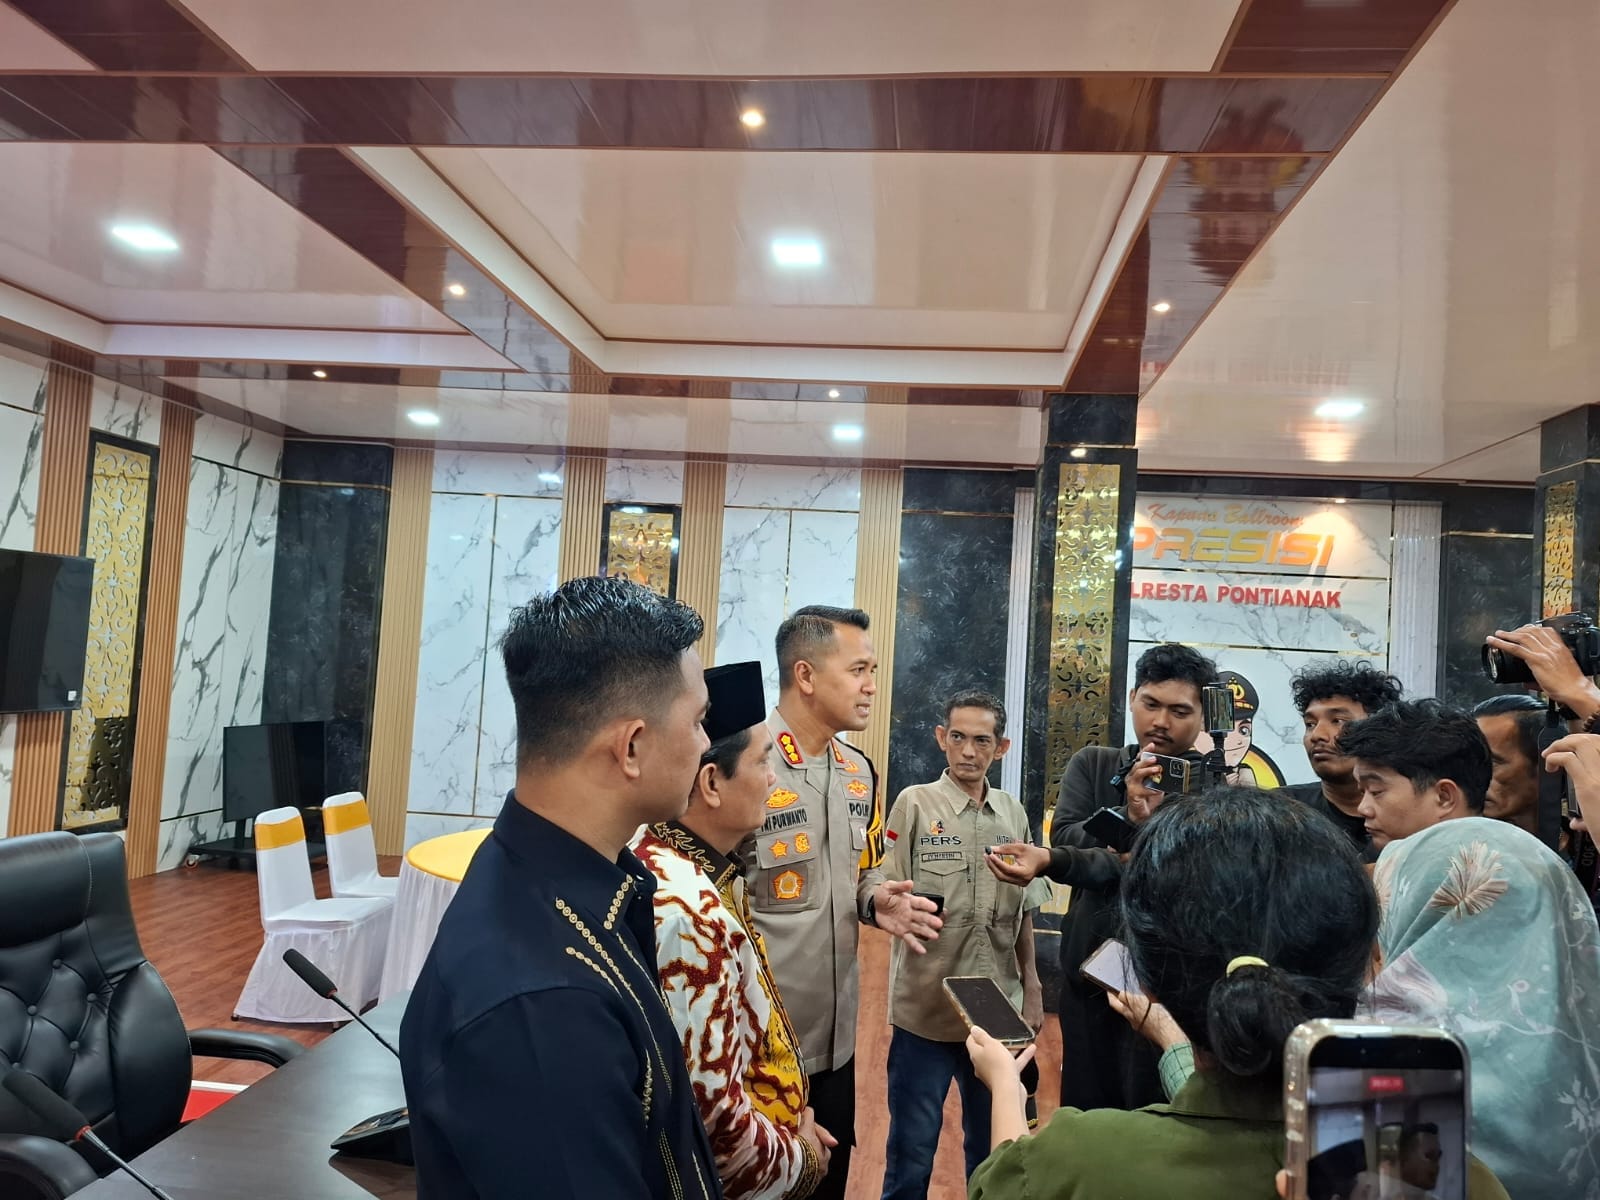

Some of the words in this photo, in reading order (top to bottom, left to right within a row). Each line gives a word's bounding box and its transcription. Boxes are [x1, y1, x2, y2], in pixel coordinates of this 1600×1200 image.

[1223, 503, 1304, 528] Ballroom
[1133, 526, 1335, 567] PRESISI
[1131, 581, 1208, 603] LRESTA
[1216, 585, 1341, 609] PONTIANAK
[920, 835, 962, 846] PERS
